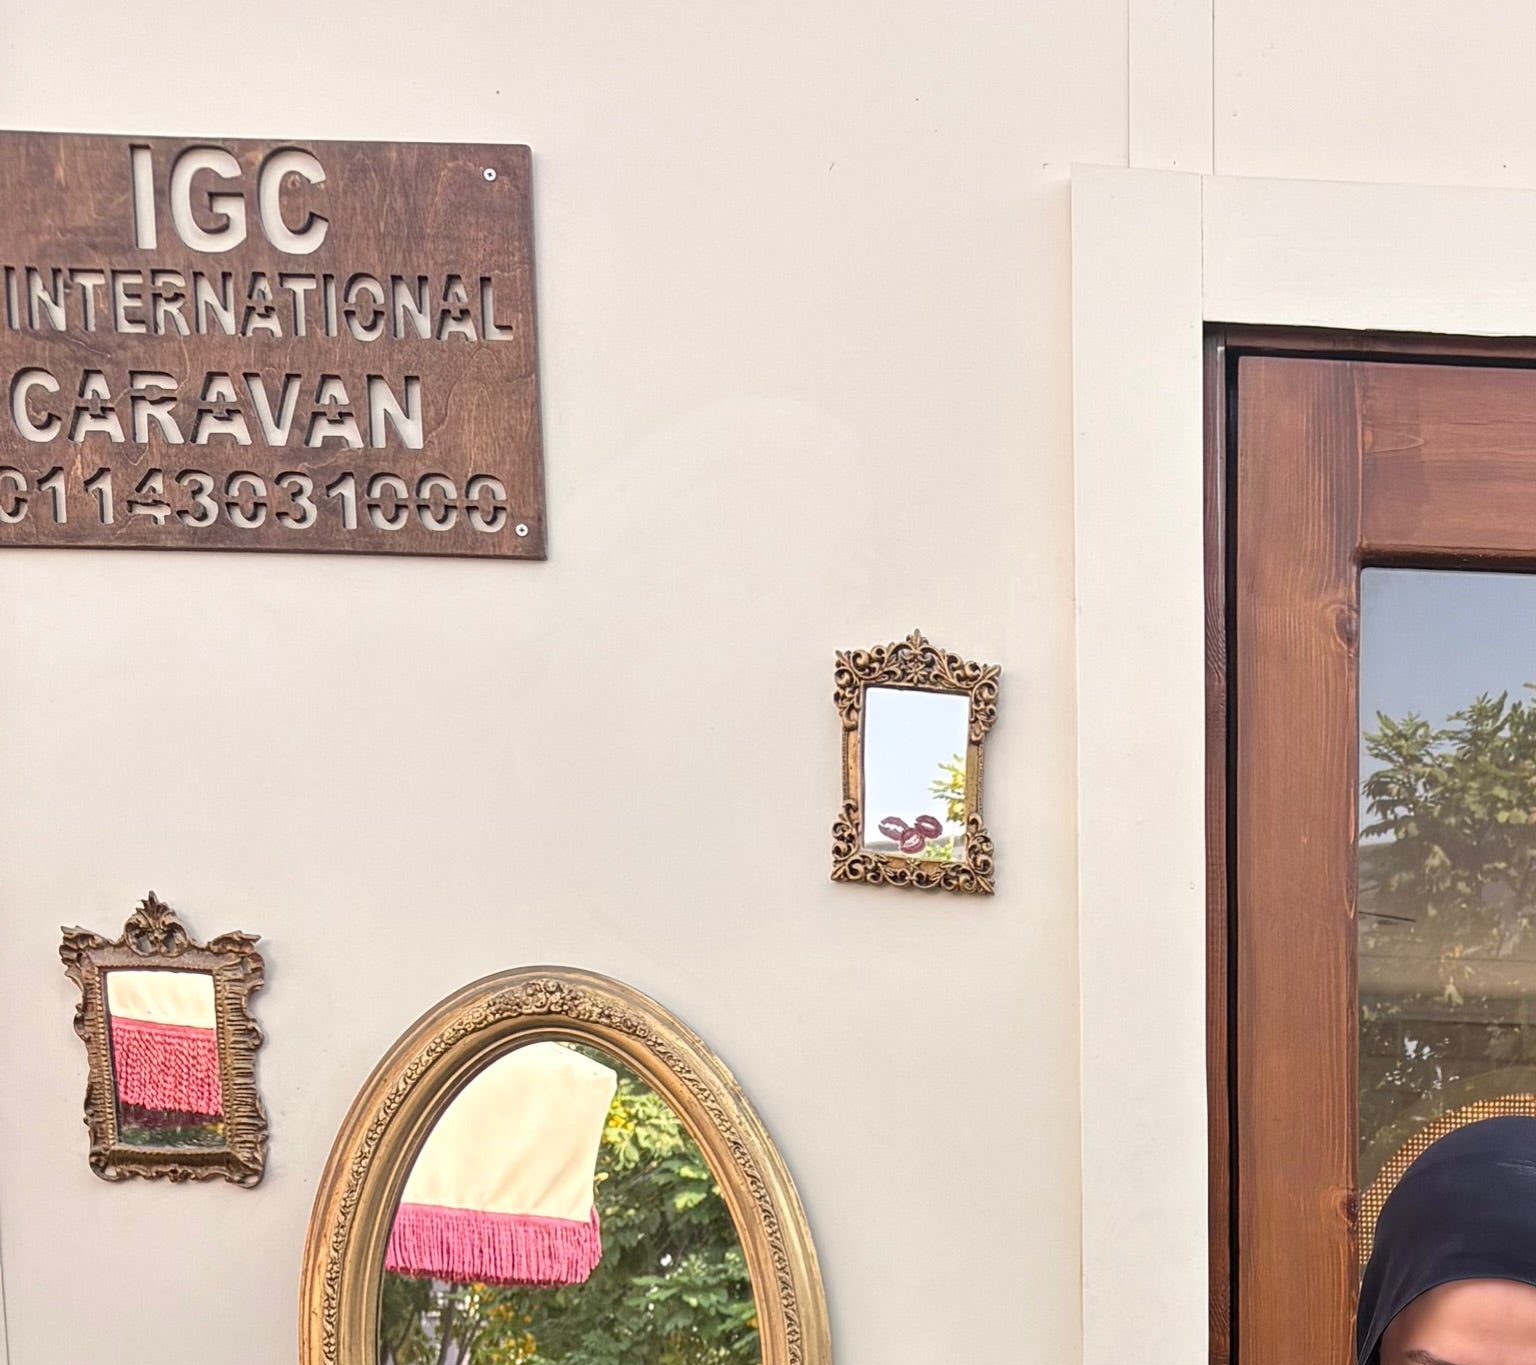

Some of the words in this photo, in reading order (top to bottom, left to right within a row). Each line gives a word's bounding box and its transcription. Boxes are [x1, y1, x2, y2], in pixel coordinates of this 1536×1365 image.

[128, 143, 330, 254] IGC
[2, 265, 515, 343] INTERNATIONAL
[9, 366, 426, 450] CARAVAN
[0, 465, 509, 534] 01143031000
